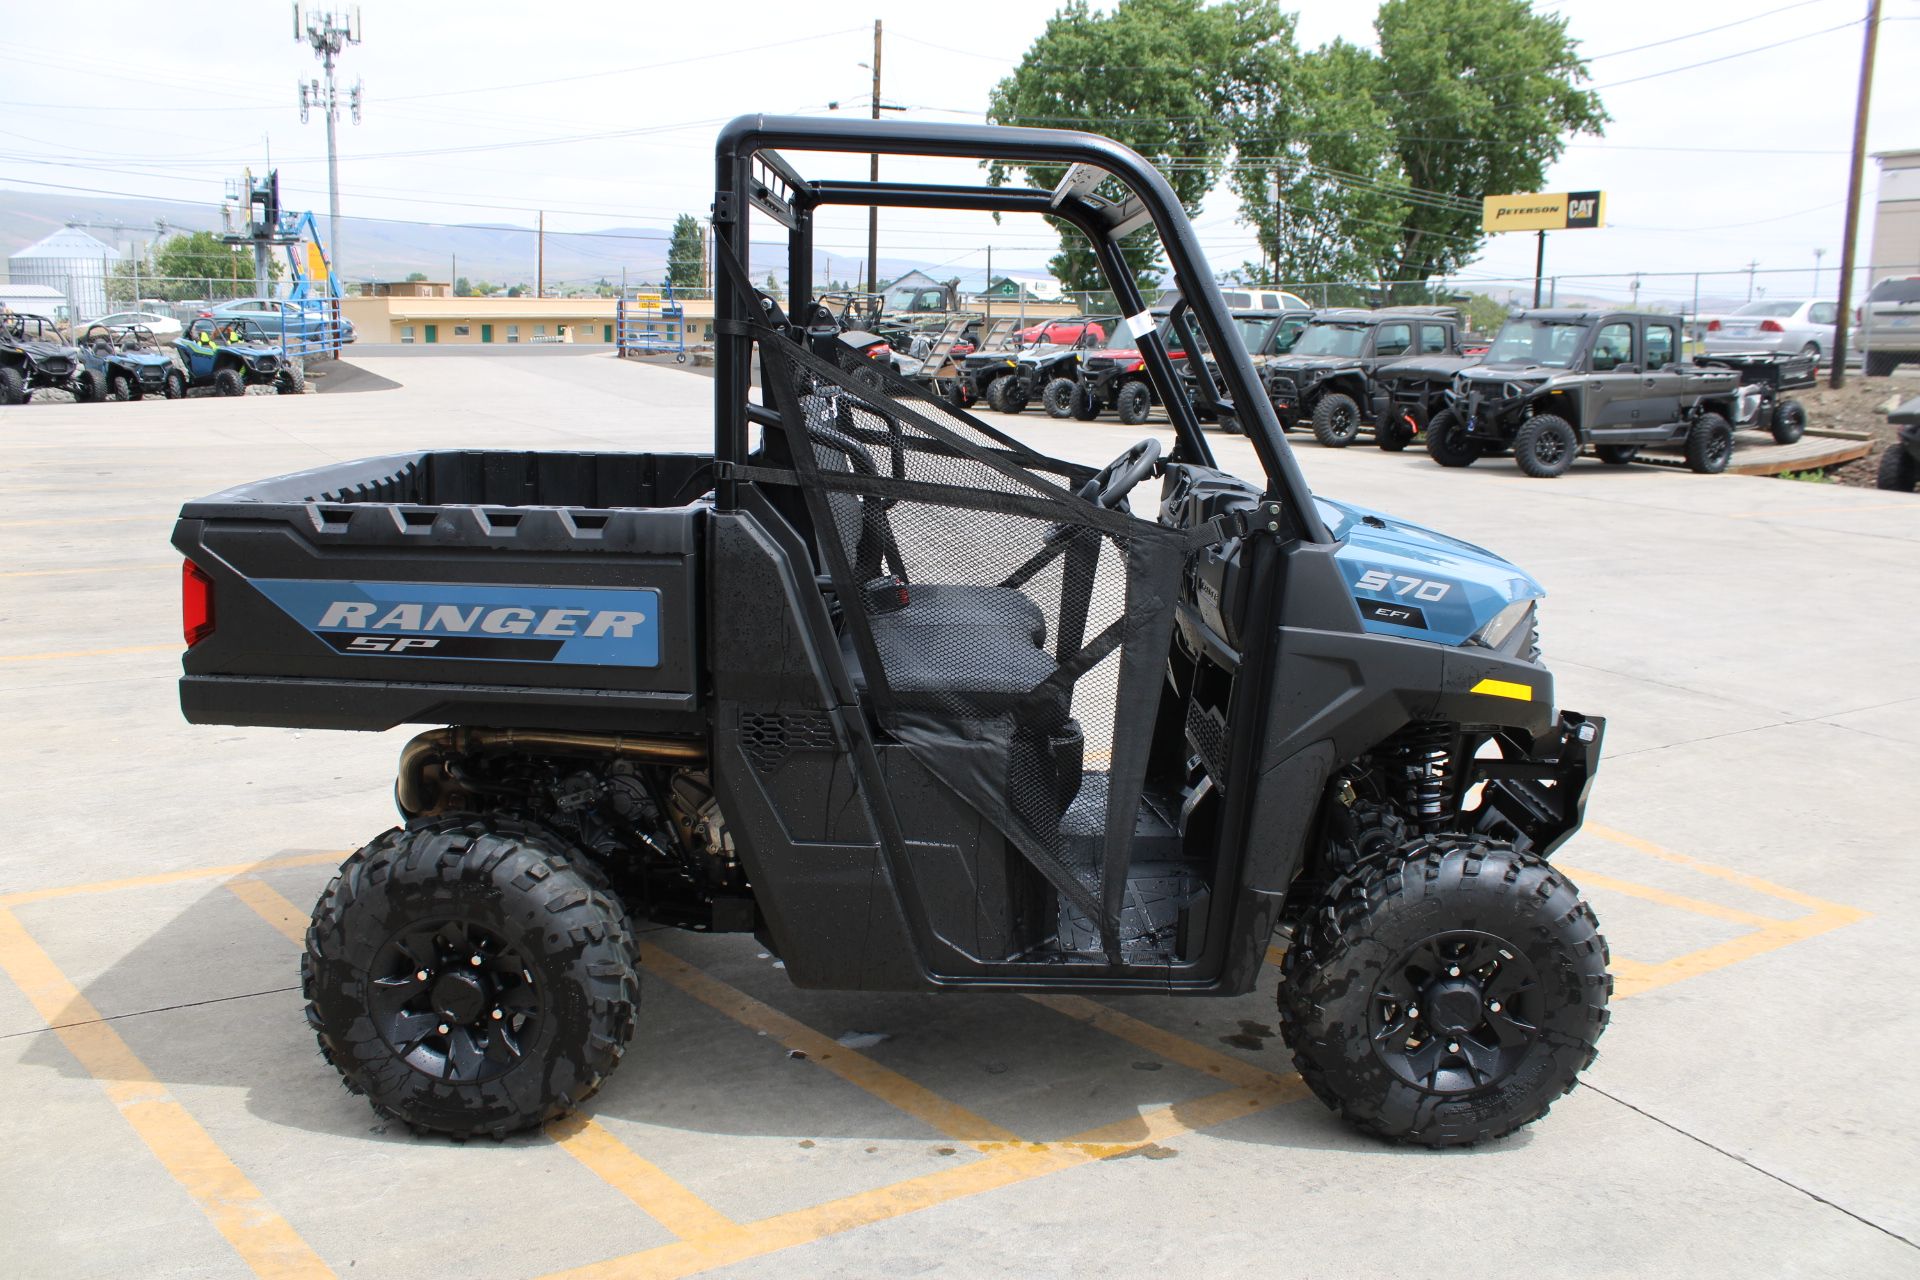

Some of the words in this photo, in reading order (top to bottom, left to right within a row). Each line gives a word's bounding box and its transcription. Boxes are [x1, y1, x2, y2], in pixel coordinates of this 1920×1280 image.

[1496, 206, 1559, 219] PETERSON
[1568, 200, 1595, 219] CAT
[318, 601, 646, 638] RANGER
[1375, 607, 1410, 620] EFI
[345, 636, 441, 652] SP
